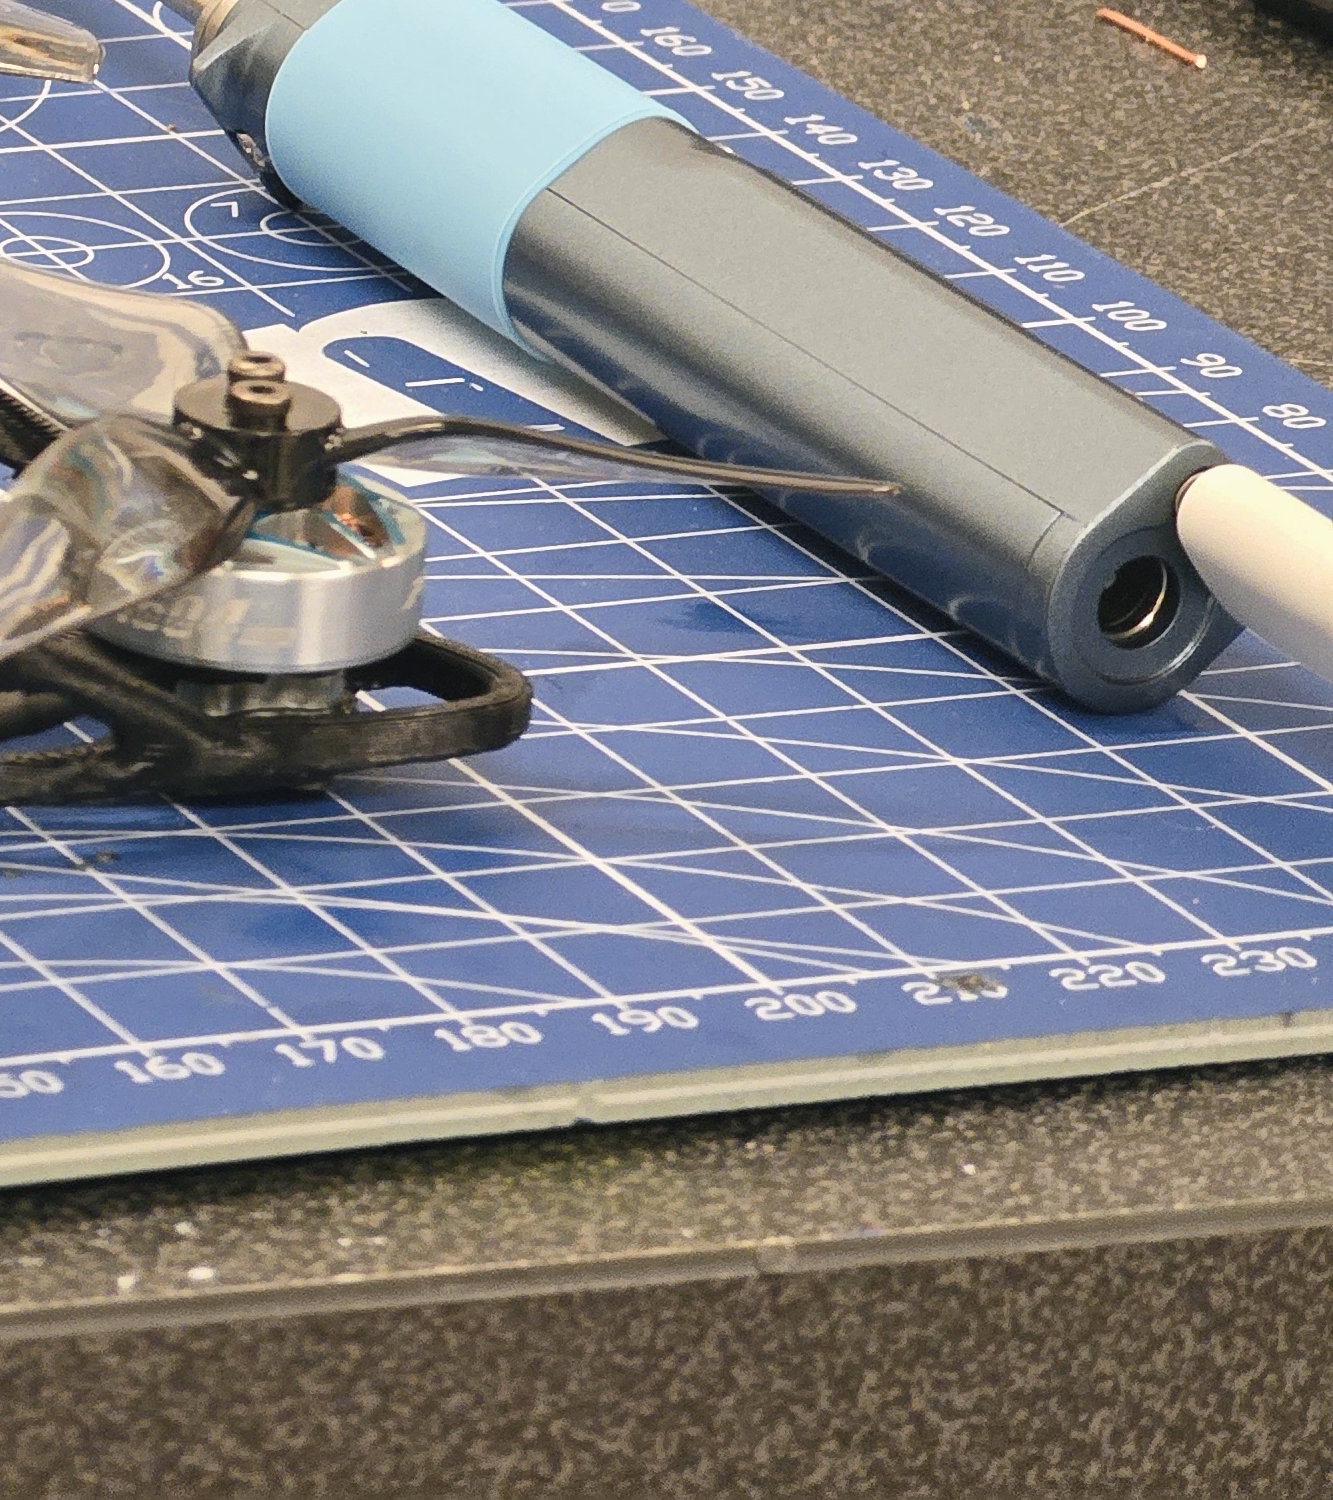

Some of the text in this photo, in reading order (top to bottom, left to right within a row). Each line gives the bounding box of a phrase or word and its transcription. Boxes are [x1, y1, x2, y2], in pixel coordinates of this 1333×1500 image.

[210, 200, 240, 218] 7
[639, 25, 713, 57] 160
[710, 69, 786, 101] 150
[783, 113, 859, 146] 140
[858, 158, 934, 192] 130
[933, 204, 1011, 238] 120
[1013, 253, 1086, 283] 110
[1091, 300, 1168, 332] 100
[1179, 352, 1244, 379] 90
[1261, 402, 1327, 430] 80
[161, 269, 225, 291] 16
[113, 1050, 227, 1085] 160
[274, 1035, 387, 1068] 170
[434, 1020, 544, 1053] 180
[590, 1005, 700, 1037] 190
[743, 990, 859, 1022] 200
[1049, 960, 1167, 992] 220
[1200, 945, 1319, 978] 230
